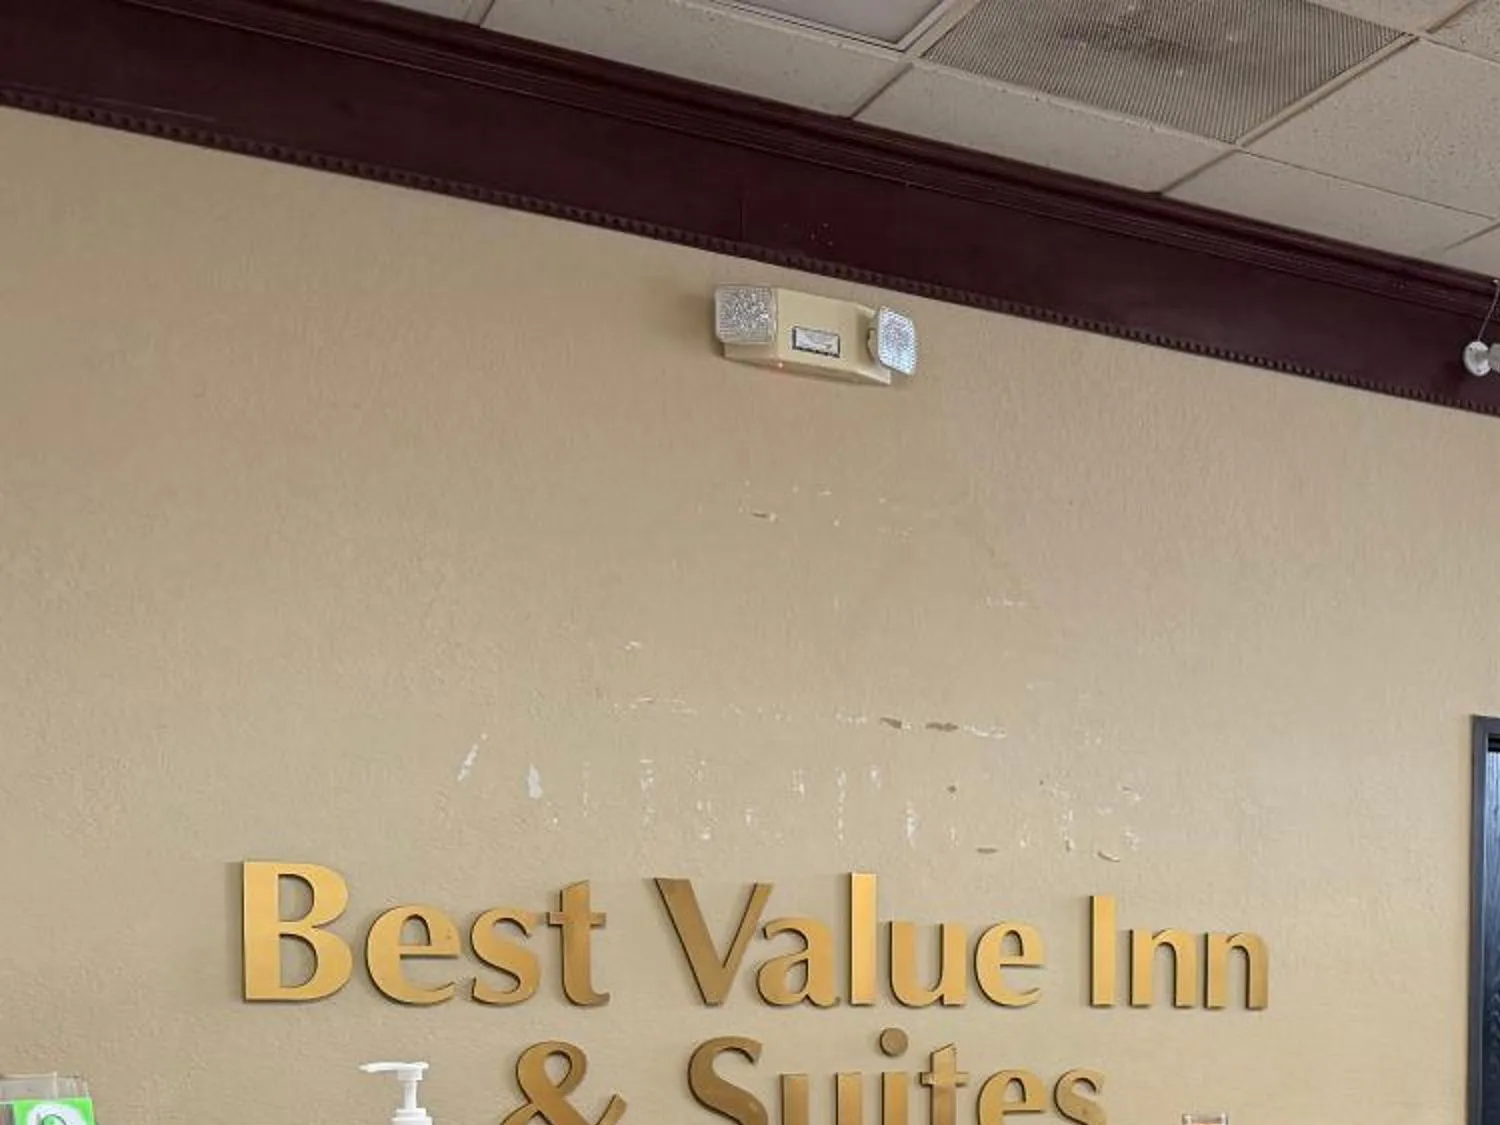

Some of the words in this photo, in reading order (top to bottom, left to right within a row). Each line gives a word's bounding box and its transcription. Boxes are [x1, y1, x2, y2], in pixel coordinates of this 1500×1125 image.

[243, 861, 611, 1006] Best
[654, 872, 1045, 1007] Value
[1089, 895, 1268, 1010] Inn
